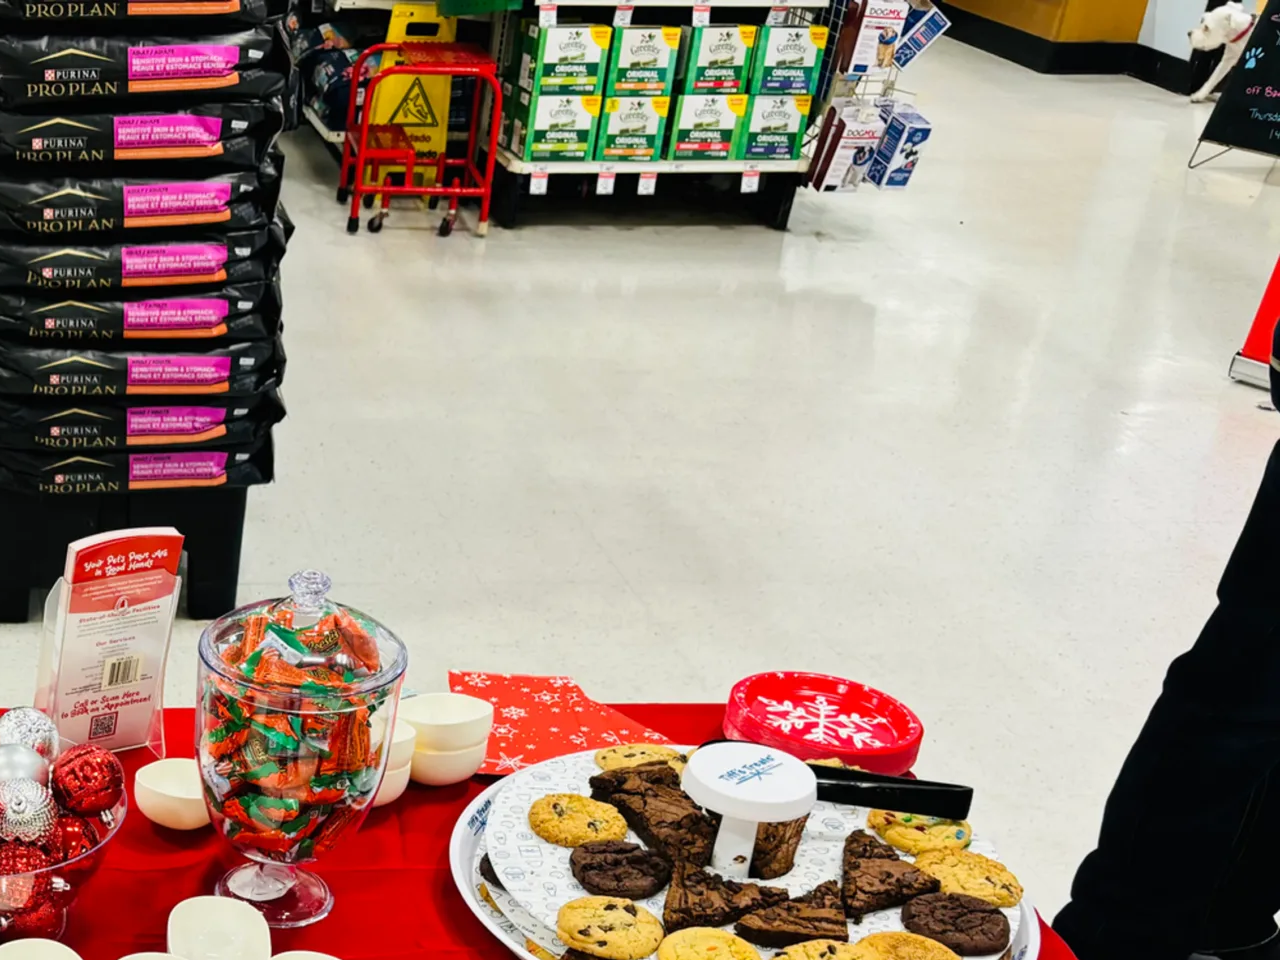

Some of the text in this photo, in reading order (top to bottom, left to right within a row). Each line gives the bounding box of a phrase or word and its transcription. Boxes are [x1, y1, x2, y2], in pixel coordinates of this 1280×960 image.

[25, 3, 117, 17] PRO PLAN
[555, 65, 587, 73] ORIGINAL
[56, 70, 97, 80] PURINA
[27, 82, 118, 97] PRO PLAN
[689, 131, 721, 139] ORIGINAL
[43, 138, 84, 148] PURINA
[615, 137, 647, 145] ORIGINAL
[54, 208, 94, 218] PURINA
[27, 218, 114, 232] PRO PLAN
[53, 268, 93, 277] PURINA
[56, 319, 95, 328] PURINA
[61, 375, 99, 384] PURINA
[61, 427, 99, 435] PURINA
[72, 435, 117, 447] PLAN
[65, 474, 101, 482] PURINA
[75, 481, 119, 493] PLAN
[74, 699, 89, 709] Call
[101, 695, 120, 704] Scan
[122, 691, 140, 700] Here
[61, 711, 69, 719] to
[101, 694, 152, 711] Appointment
